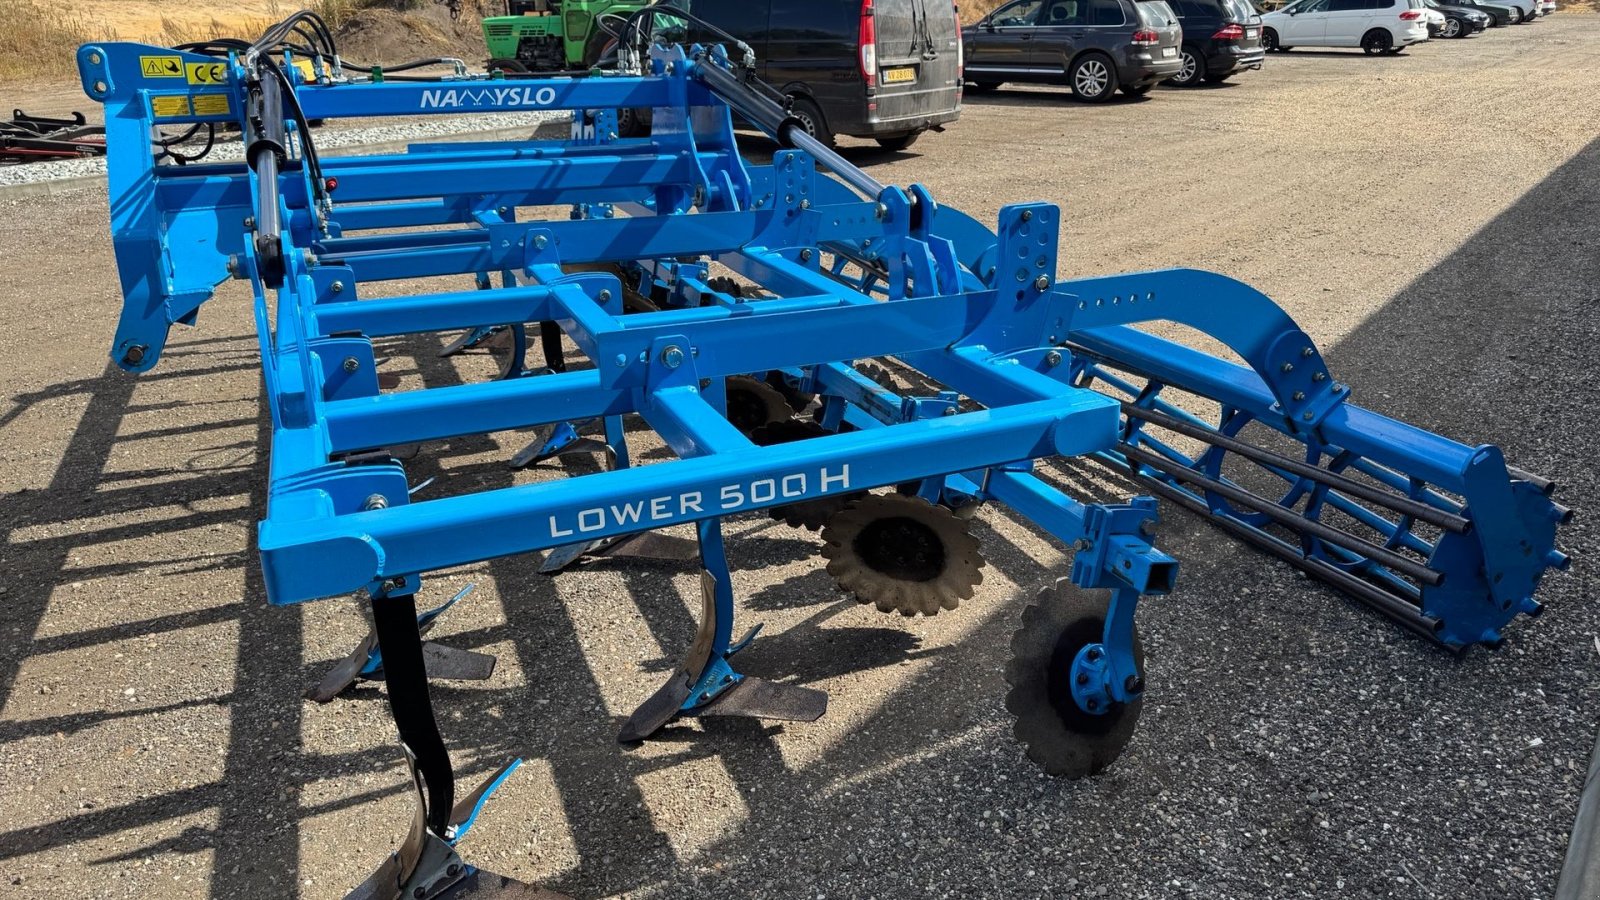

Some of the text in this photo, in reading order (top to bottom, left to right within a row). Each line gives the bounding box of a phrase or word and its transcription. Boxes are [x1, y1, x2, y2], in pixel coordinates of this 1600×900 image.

[195, 65, 222, 82] CE
[420, 87, 556, 108] NAMYSLO
[549, 464, 849, 538] LOWER 500 H
